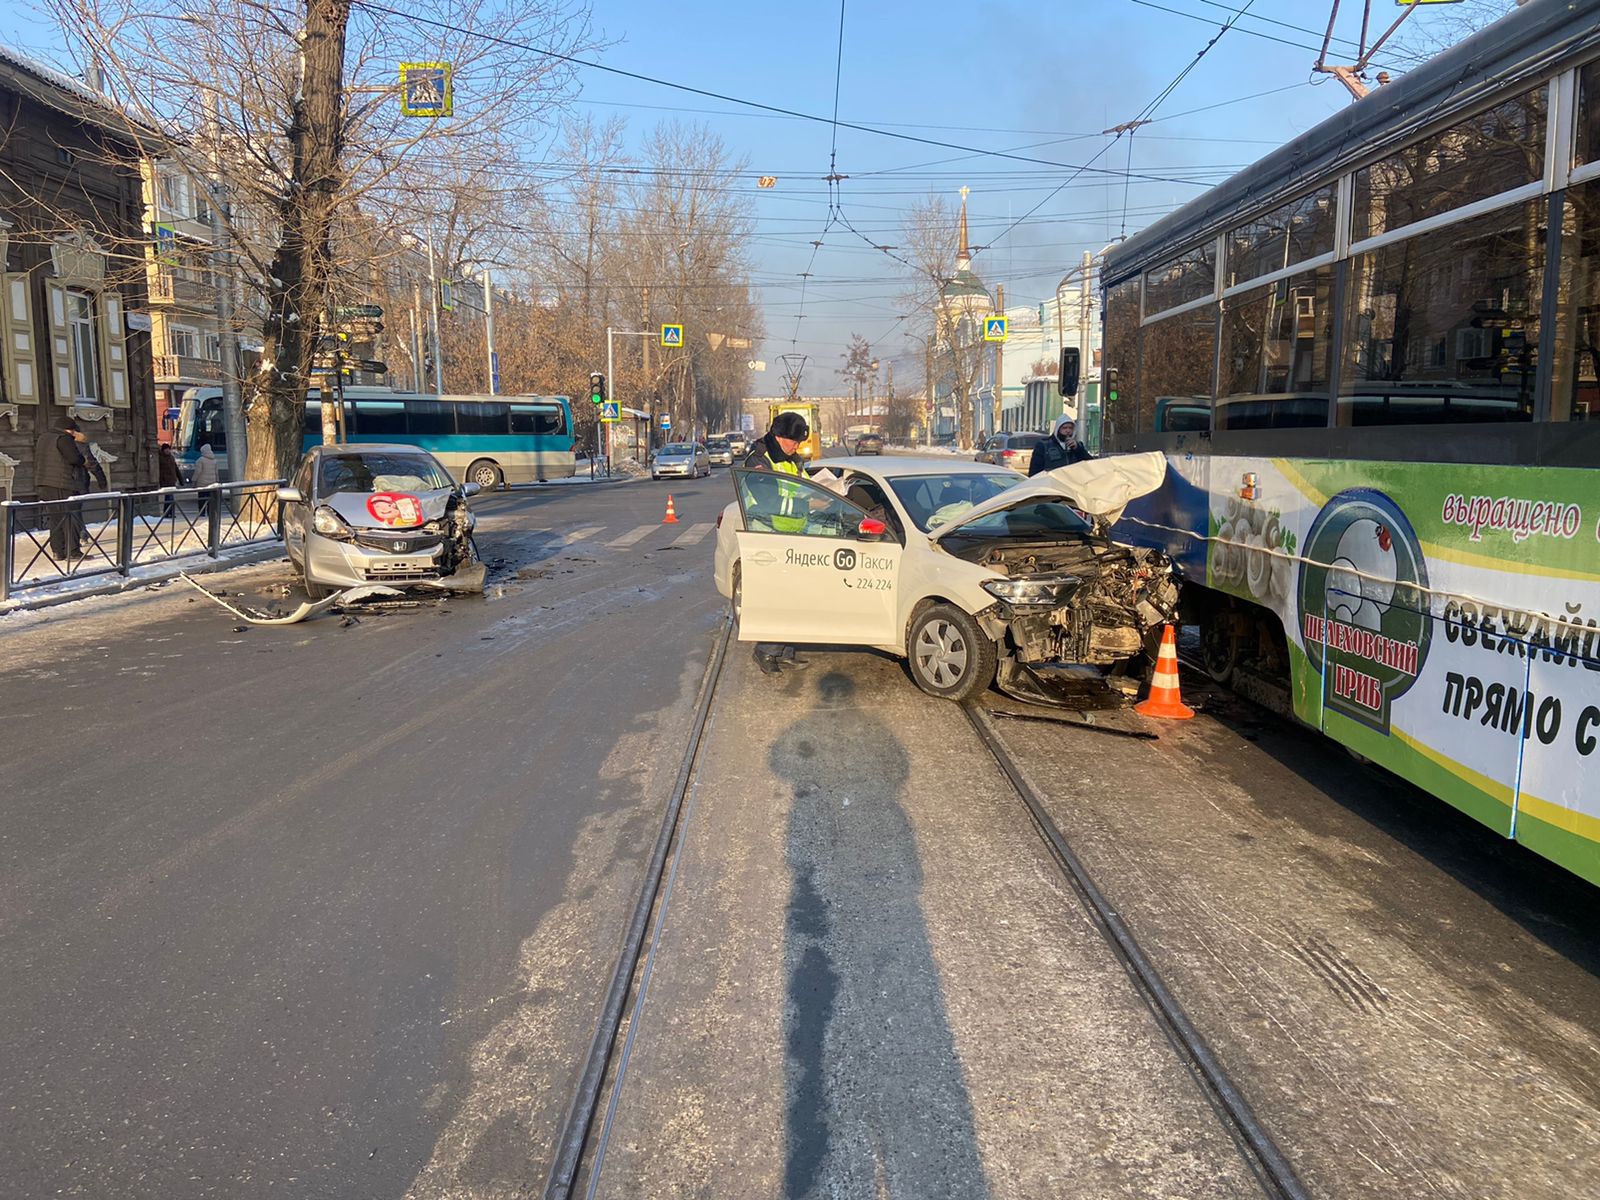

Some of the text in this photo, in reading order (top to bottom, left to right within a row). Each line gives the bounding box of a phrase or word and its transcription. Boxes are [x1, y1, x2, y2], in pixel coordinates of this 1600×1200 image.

[1442, 493, 1582, 543] выращено
[785, 548, 893, 570] Яндекс Go Такси
[857, 578, 892, 590] 224 224
[1304, 613, 1418, 677] ШЕЛЕХОВСКИЙ
[1335, 663, 1382, 711] ГРИБ
[1442, 671, 1562, 745] ПРЯМО
